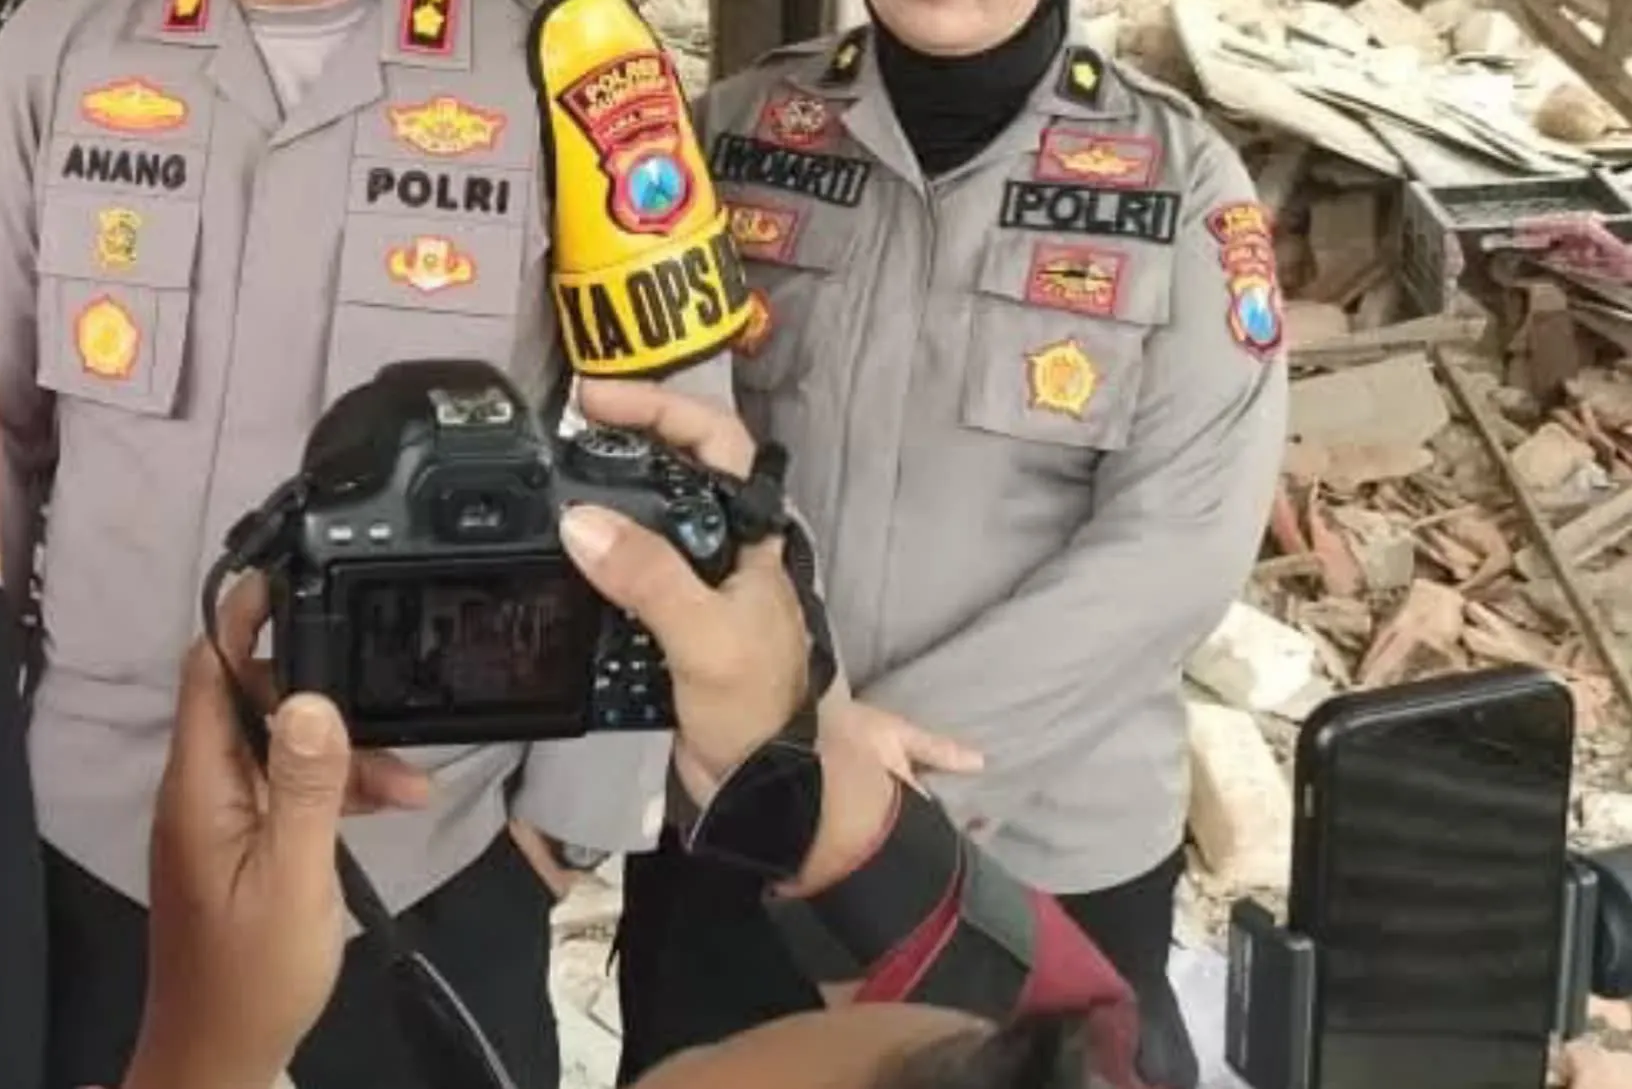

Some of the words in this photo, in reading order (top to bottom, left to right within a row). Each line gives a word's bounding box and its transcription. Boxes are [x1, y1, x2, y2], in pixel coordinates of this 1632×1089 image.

[61, 143, 187, 191] ANANG
[367, 167, 510, 215] POLRI
[1015, 184, 1167, 237] POLRI
